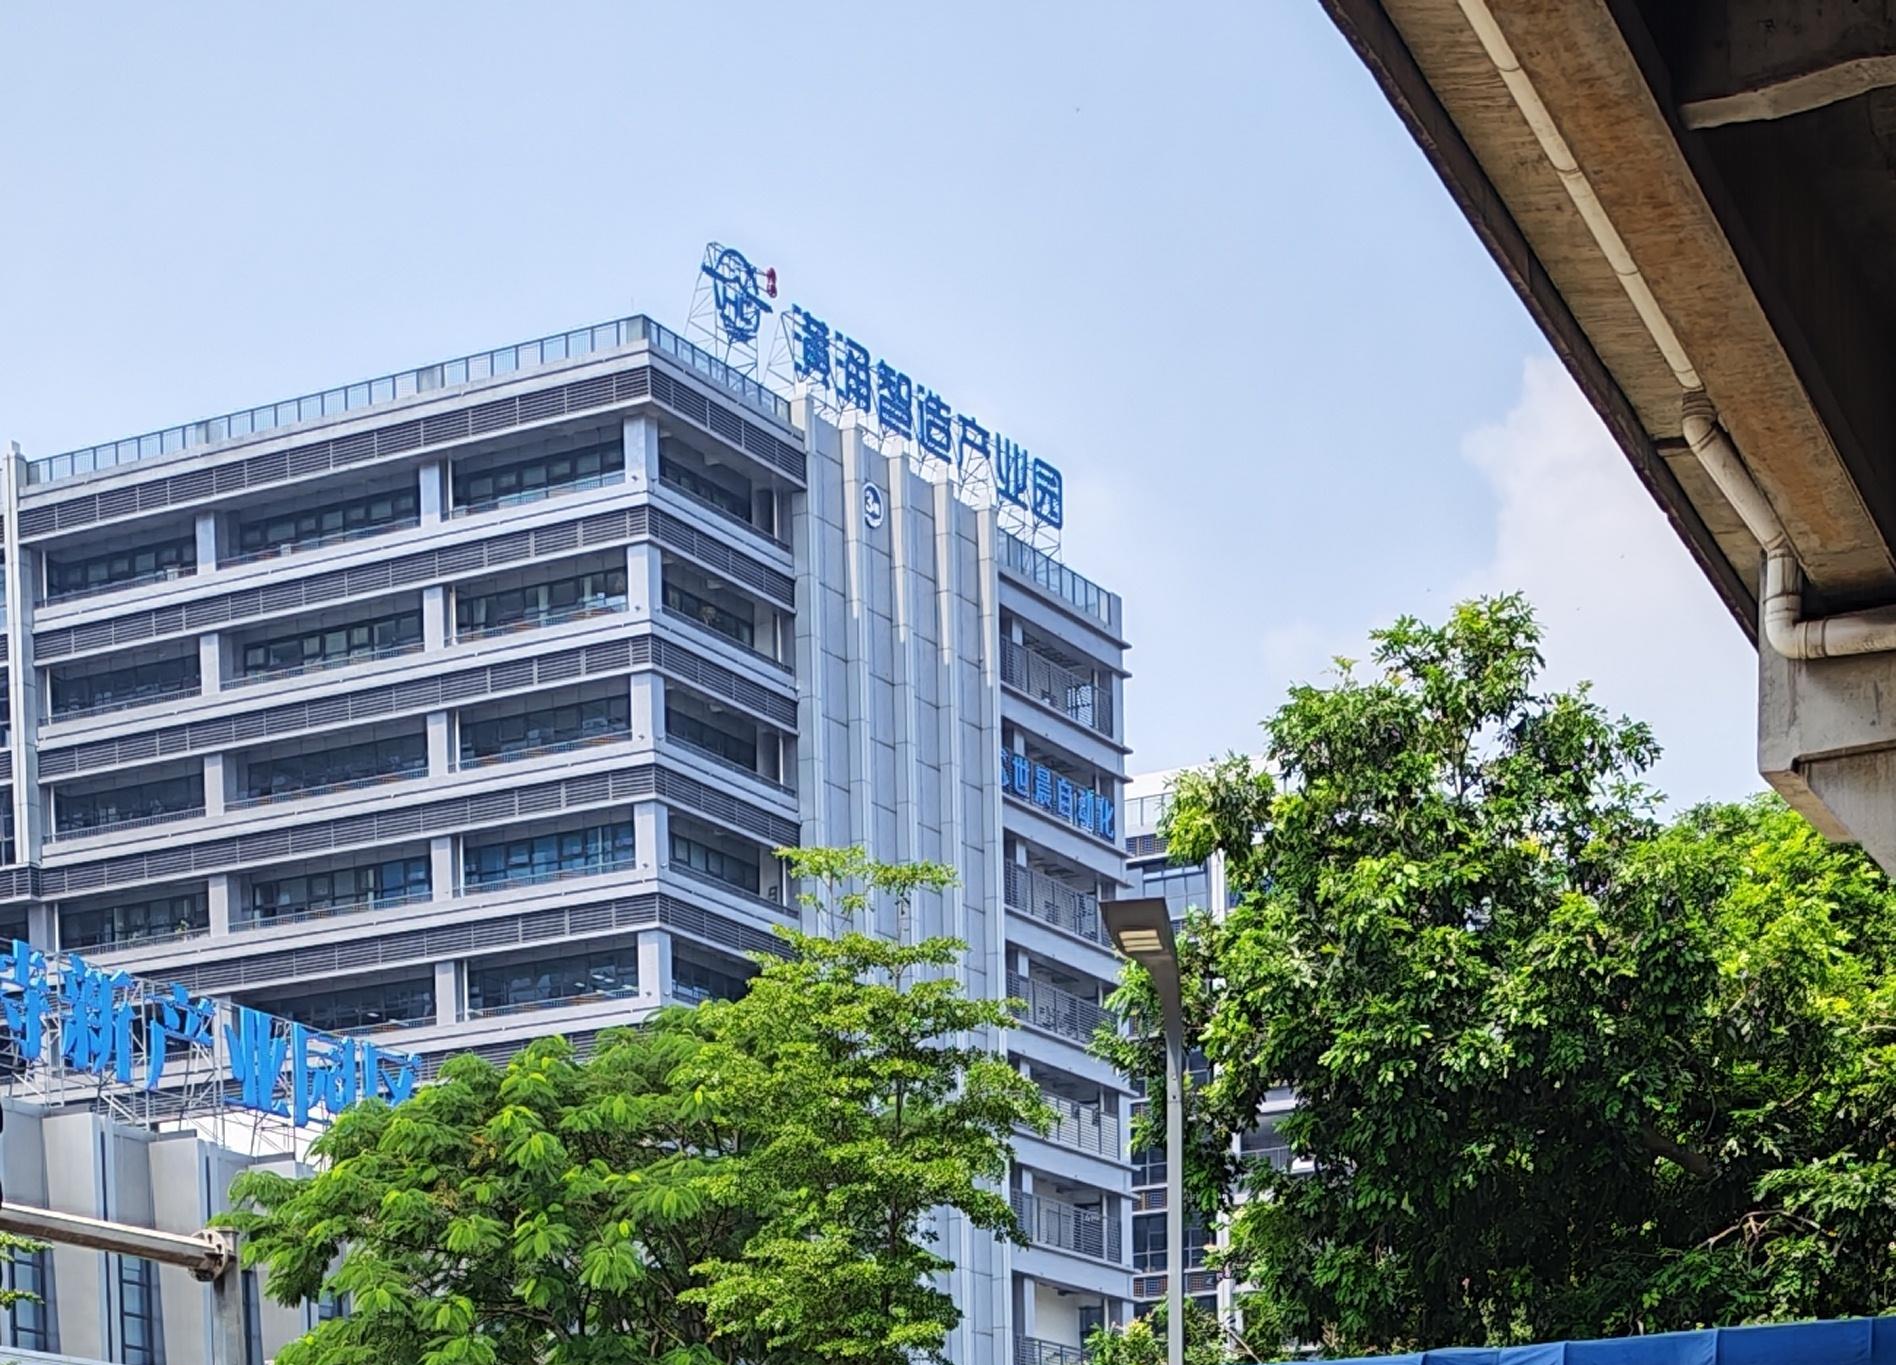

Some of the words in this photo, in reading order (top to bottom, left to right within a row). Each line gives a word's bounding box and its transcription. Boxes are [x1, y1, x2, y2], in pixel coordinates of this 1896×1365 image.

[792, 303, 1063, 528] 潢涌智造产业园
